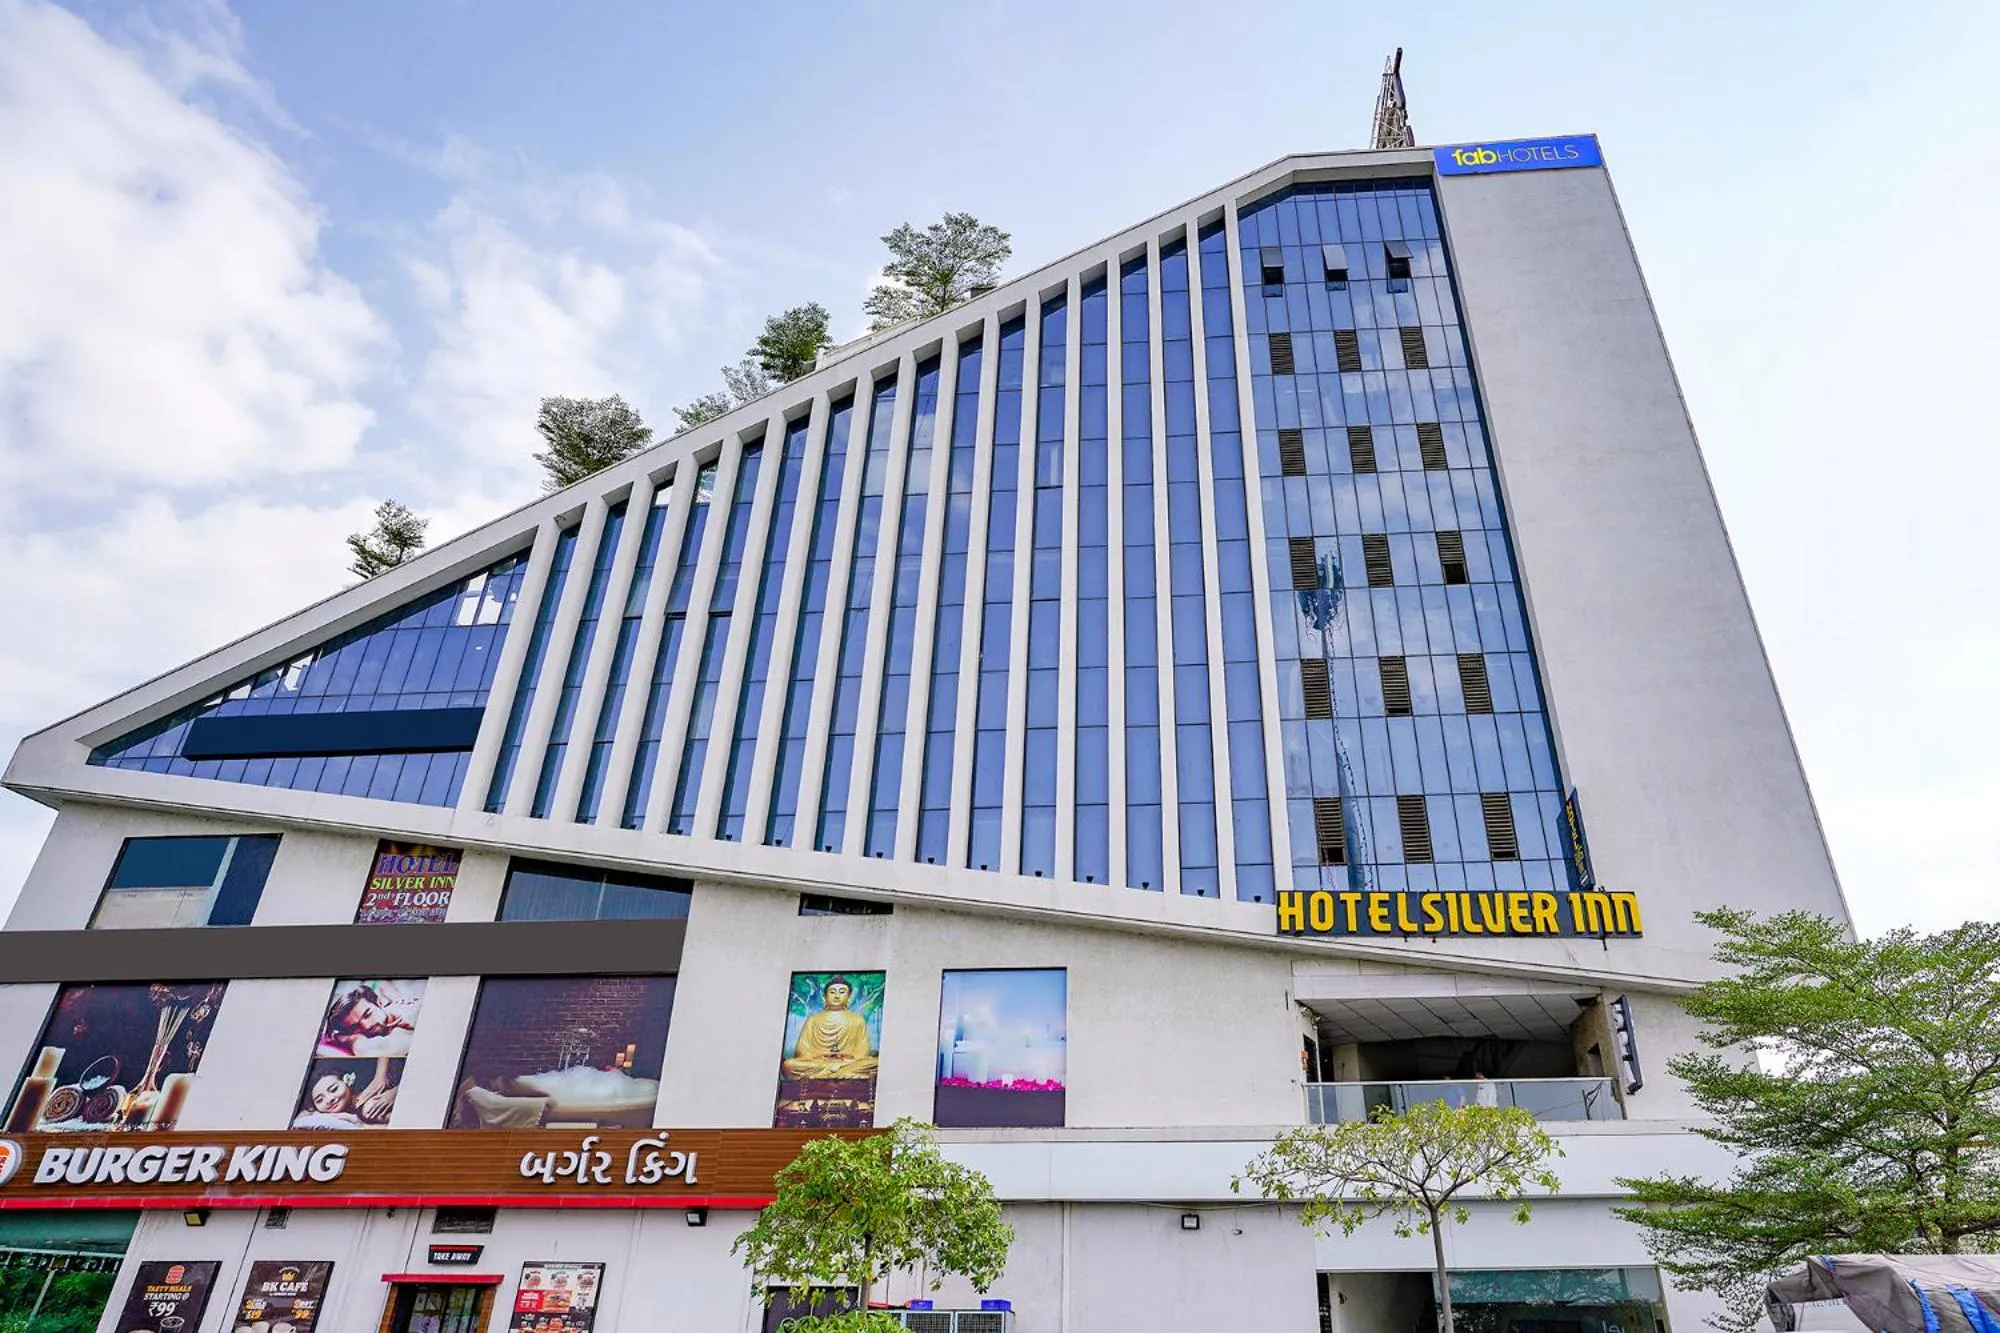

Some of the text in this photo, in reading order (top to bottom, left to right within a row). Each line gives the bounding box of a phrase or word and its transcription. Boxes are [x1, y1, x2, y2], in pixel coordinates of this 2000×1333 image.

[377, 852, 459, 874] HOTEL
[370, 876, 456, 890] SILVER INN
[366, 891, 451, 907] 2nd FLOOR
[33, 1146, 225, 1184] BURGER
[224, 1144, 349, 1182] KING
[520, 1131, 698, 1185] બર્ગર કિંગ
[433, 1252, 471, 1260] TAKE AWAY
[143, 1292, 181, 1301] STARTING
